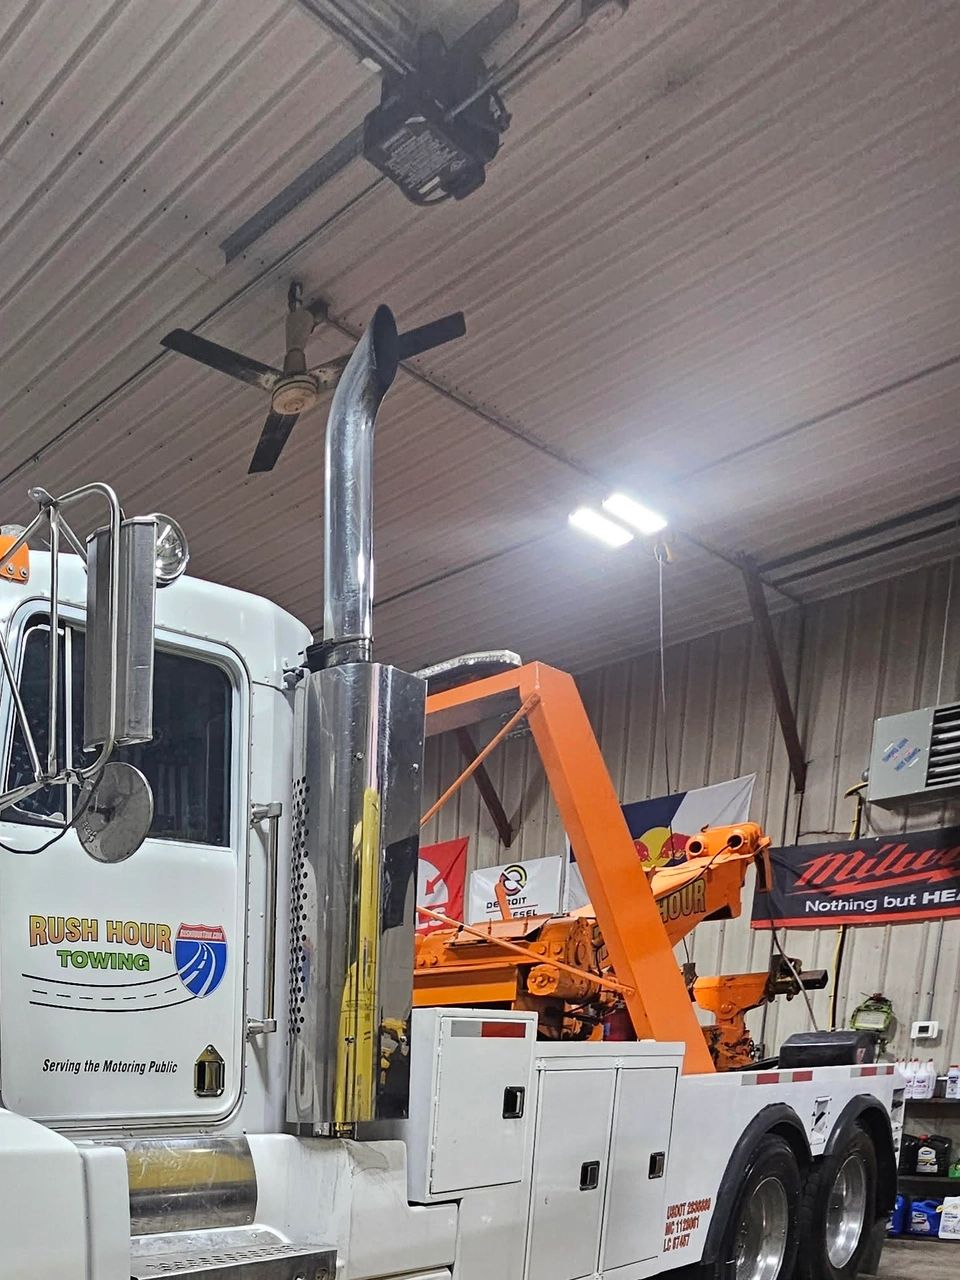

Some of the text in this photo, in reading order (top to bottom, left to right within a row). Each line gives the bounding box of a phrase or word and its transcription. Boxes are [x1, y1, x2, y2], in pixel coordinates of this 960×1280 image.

[805, 889, 960, 912] Nothing but HE
[29, 914, 172, 954] RUSH HOUR
[56, 949, 150, 971] TOWING
[42, 1058, 178, 1075] Serving the Motoring Public
